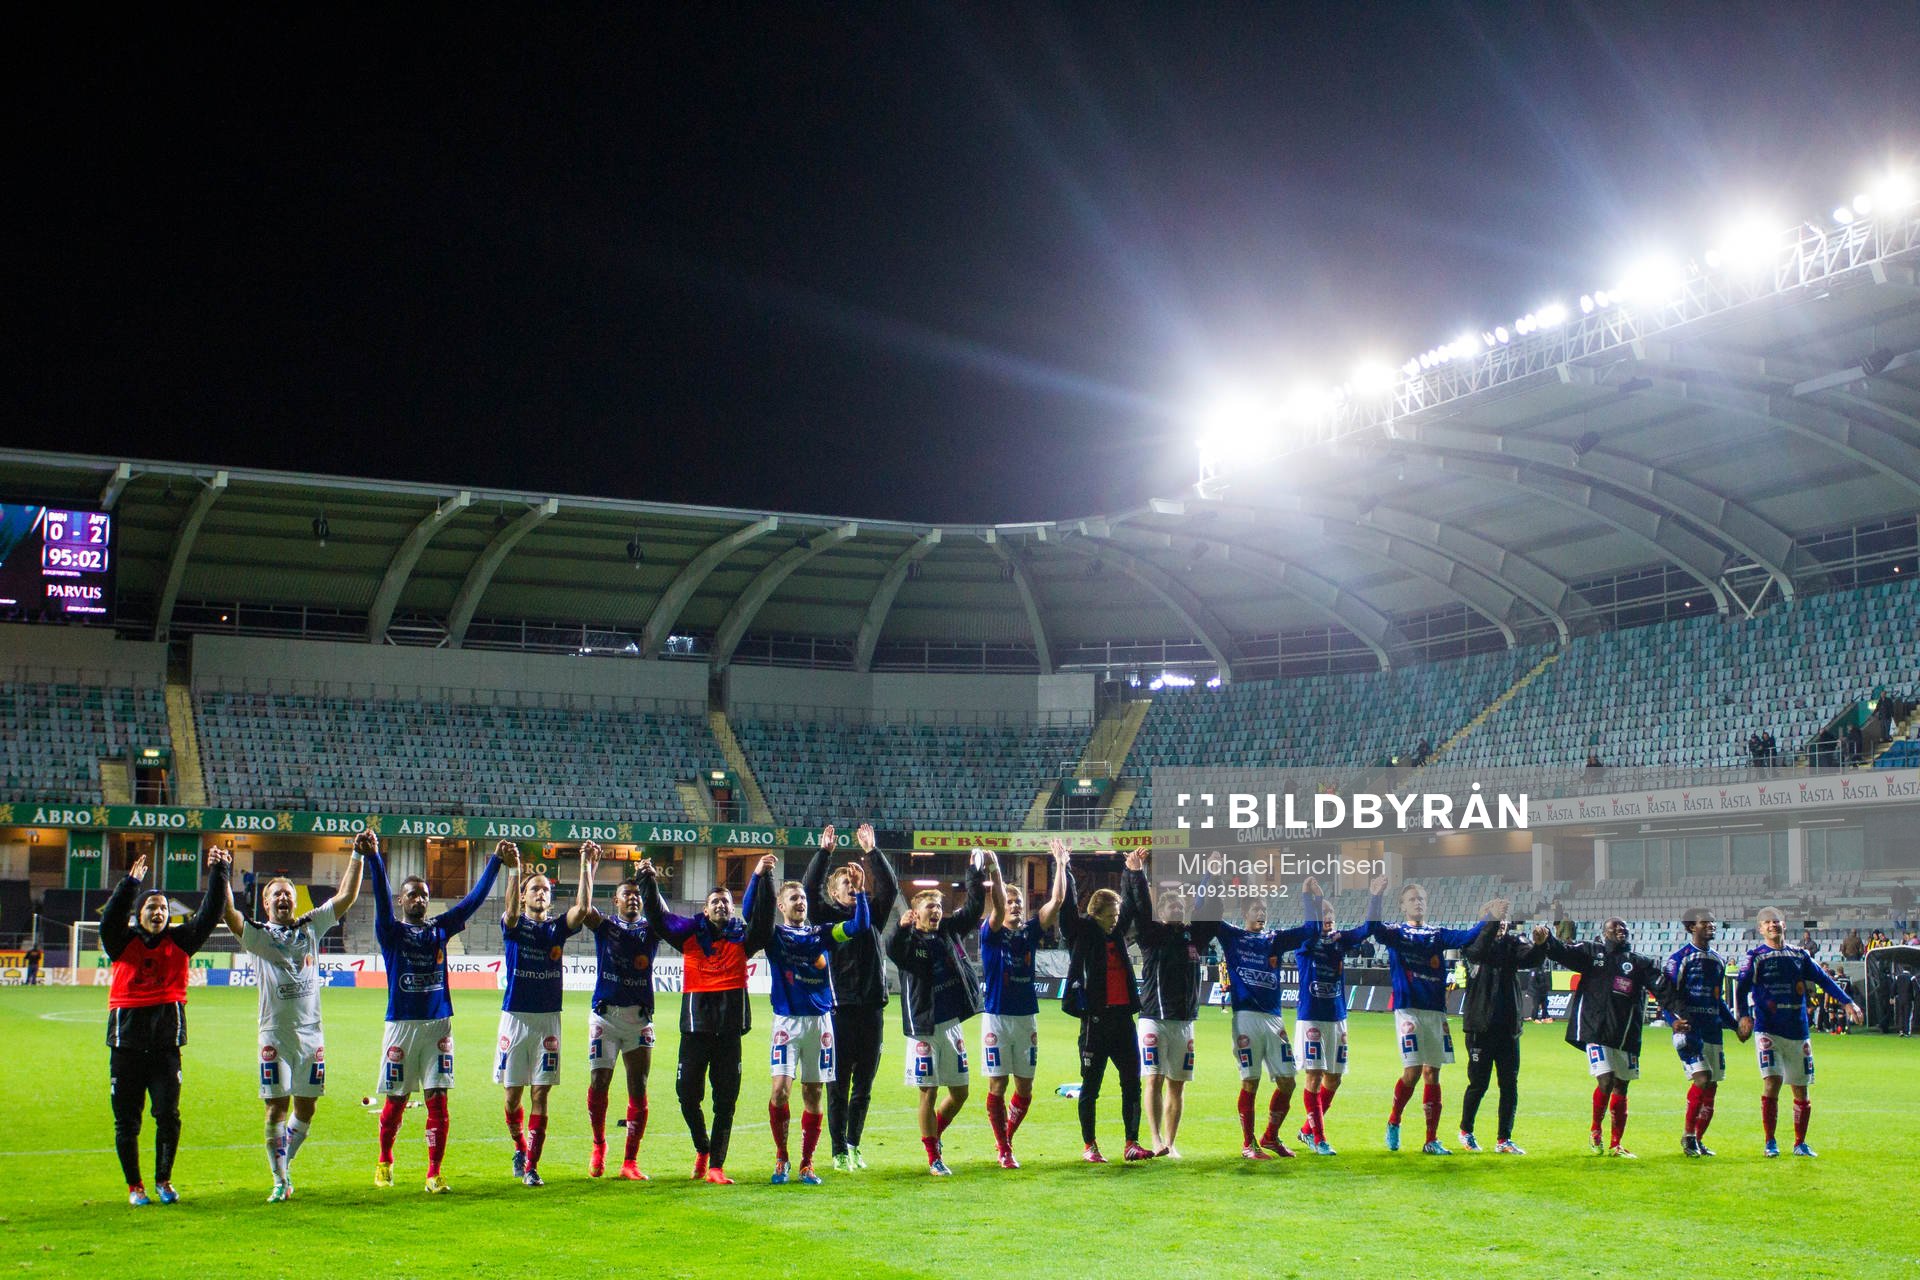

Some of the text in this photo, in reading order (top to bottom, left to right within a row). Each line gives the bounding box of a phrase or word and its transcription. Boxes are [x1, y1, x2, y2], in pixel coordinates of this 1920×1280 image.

[50, 523, 63, 540] 0
[91, 526, 102, 543] 2
[49, 548, 101, 568] 95:02
[47, 584, 102, 599] PARVUS
[1759, 792, 1792, 806] RASTA
[1800, 788, 1835, 803] RASTA
[1843, 785, 1878, 799] RASTA
[1647, 800, 1677, 814] RASTA
[1683, 797, 1714, 811] RASTA
[1720, 795, 1752, 809] RASTA
[33, 807, 91, 825] ÅBRO
[1547, 808, 1574, 822] RASTA
[1579, 805, 1607, 818] RASTA
[1612, 803, 1641, 817] RASTA
[128, 810, 186, 828] ÅBRO
[220, 813, 276, 830] ÅBRO
[311, 816, 365, 833] ÅBRO
[398, 819, 451, 836] ÅBRO
[484, 821, 536, 838] ÅBRO
[567, 824, 617, 840] ÅBRO
[649, 827, 697, 842] ÅBRO
[727, 829, 774, 844] ÅBRO
[804, 831, 850, 847] ÅO
[920, 836, 949, 846] GT
[958, 835, 1010, 847] BÄST
[1108, 835, 1185, 847] FOTBOLL
[1237, 828, 1275, 843] GAMLA
[448, 963, 481, 973] YRES
[571, 965, 596, 975] TYR
[1547, 993, 1572, 1005] stad
